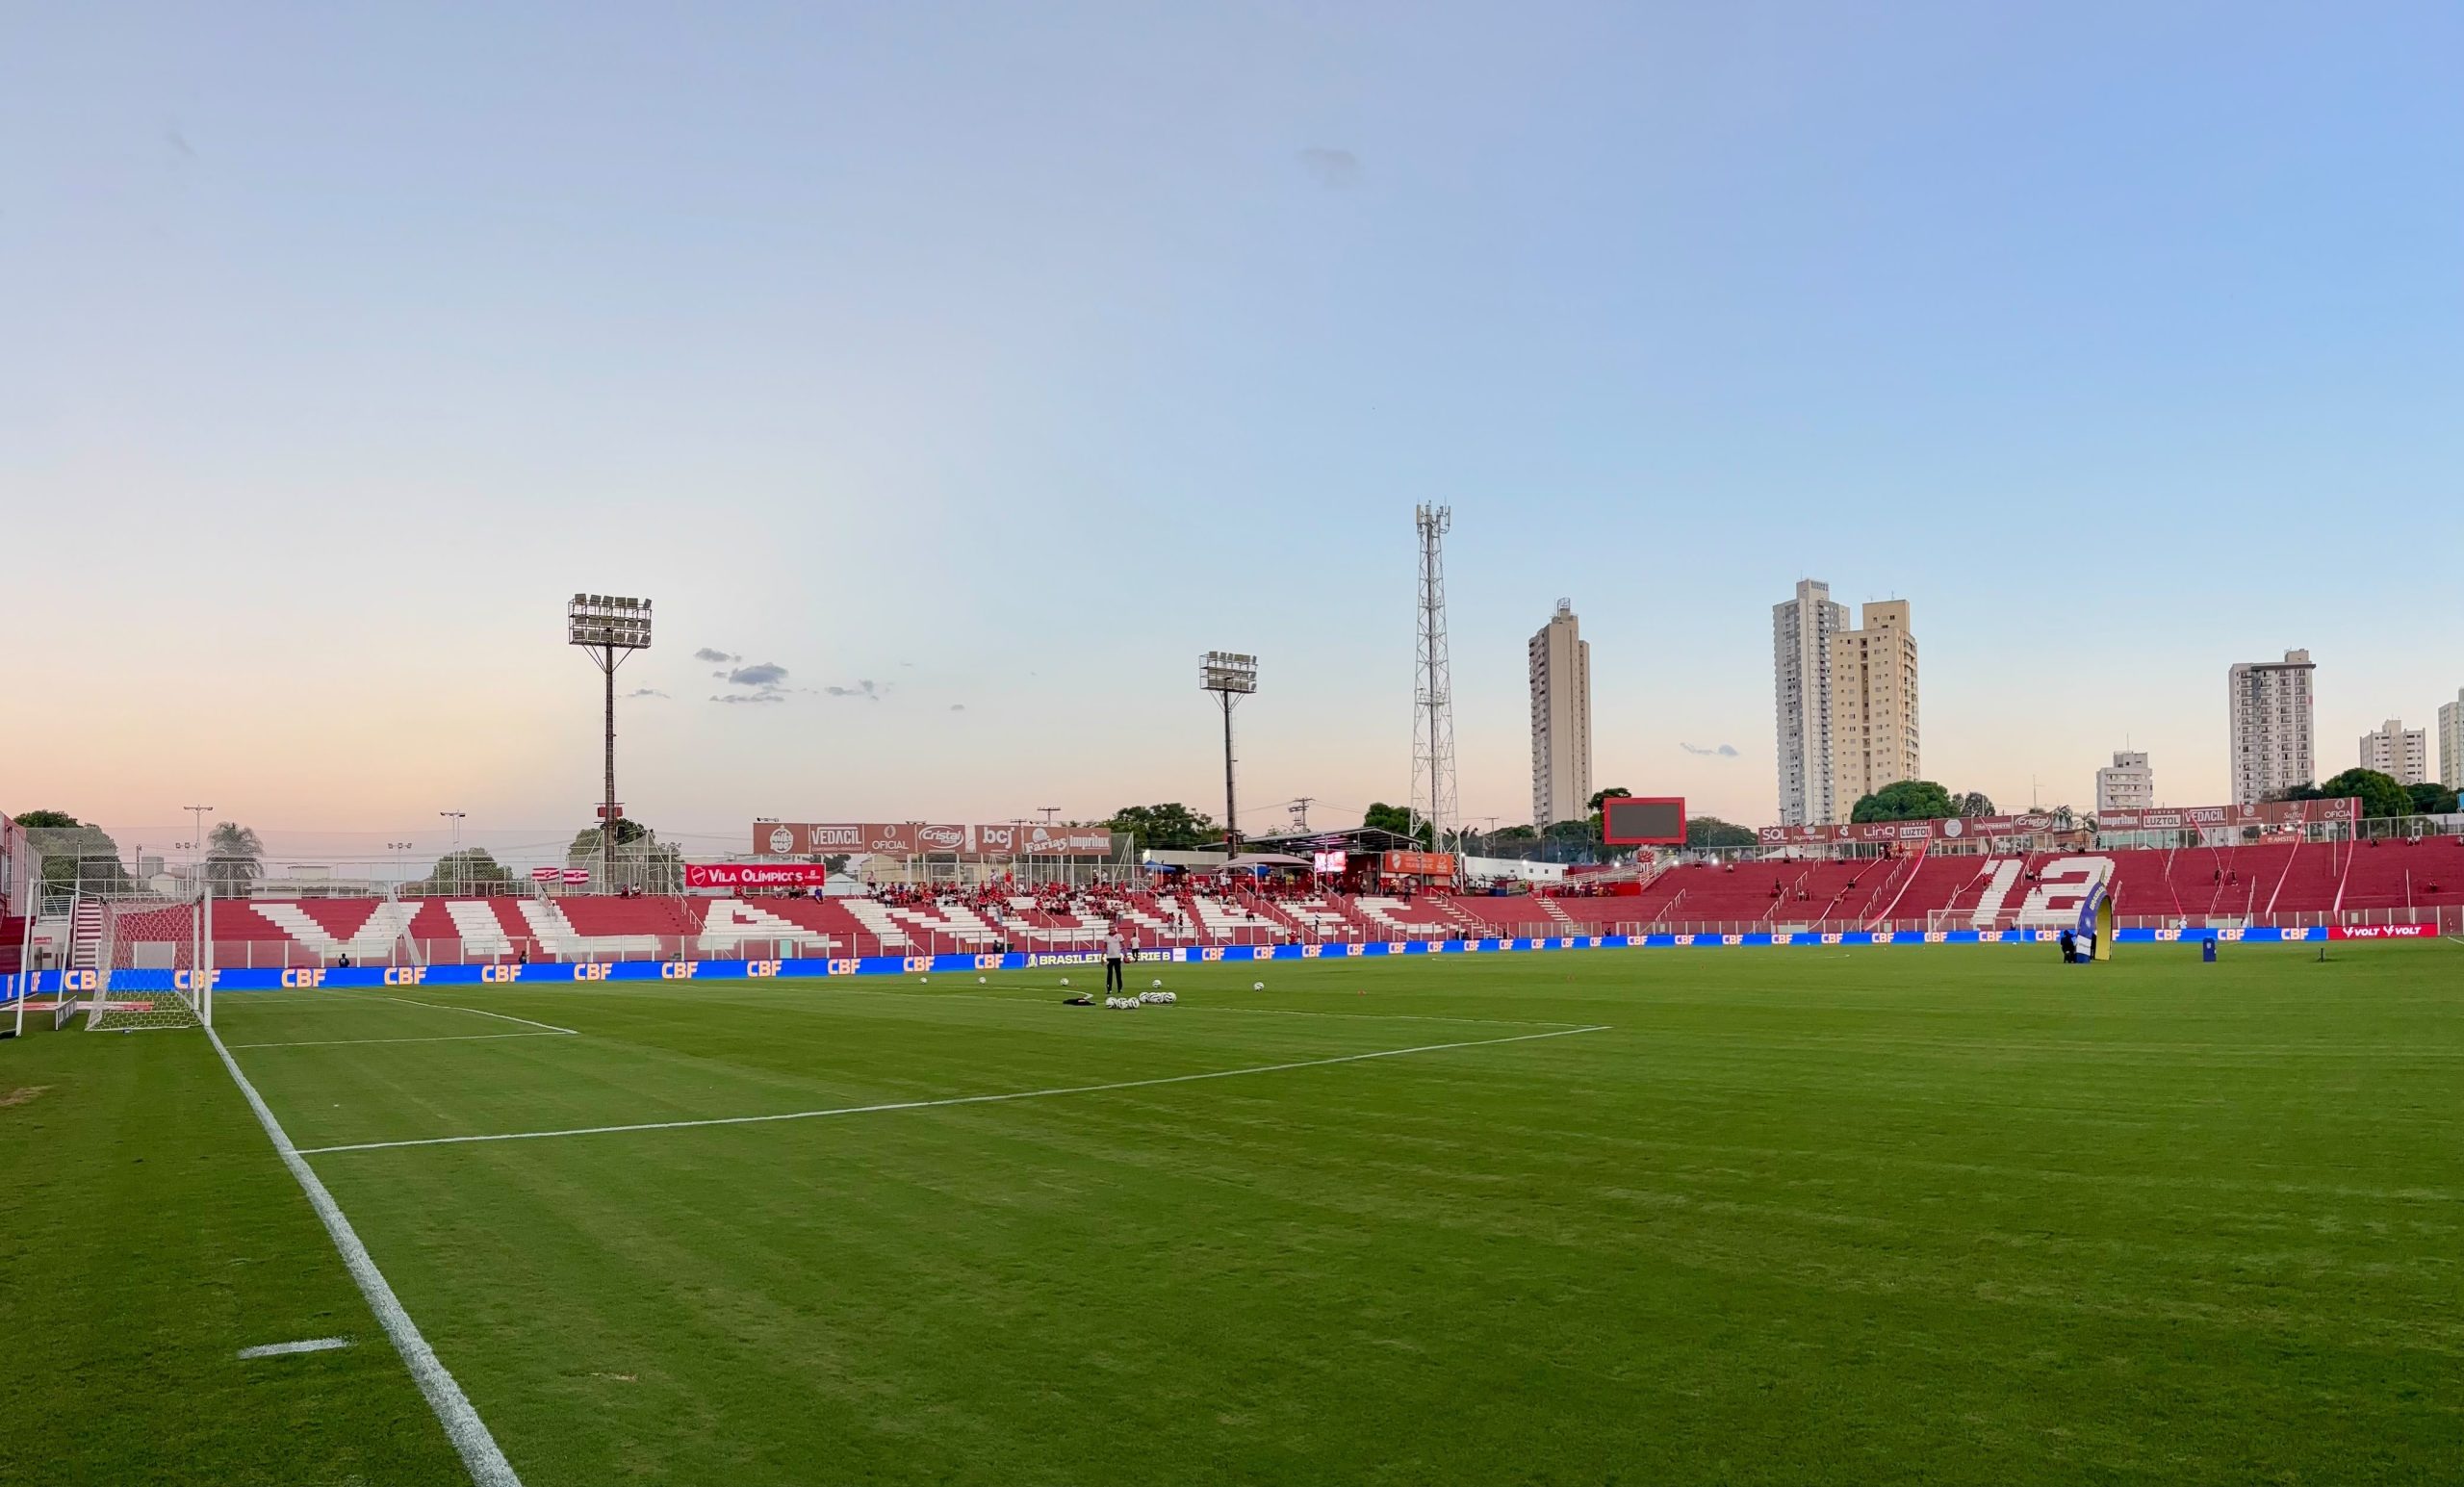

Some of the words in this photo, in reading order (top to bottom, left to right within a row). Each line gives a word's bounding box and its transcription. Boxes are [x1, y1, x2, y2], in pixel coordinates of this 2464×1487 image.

[2184, 808, 2226, 823] VEDACIL
[2324, 809, 2351, 819] OFICIA
[2017, 816, 2049, 827] Cristal
[2144, 817, 2179, 826] LUZTOL
[810, 826, 862, 845] VEDACIL
[922, 830, 962, 841] Cristal
[1761, 829, 1789, 841] SOL
[1863, 826, 1895, 837] LinQ
[871, 840, 910, 850] OFICIAL
[1024, 836, 1067, 855] Farias
[1923, 931, 1948, 943] CBF
[1978, 930, 2004, 943] CBF
[2035, 929, 2061, 942] CBF
[2154, 928, 2182, 941] CBF
[2217, 927, 2246, 941] CBF
[2280, 927, 2310, 940] CBF
[2354, 927, 2380, 936] VOLT
[2395, 926, 2422, 936] VOLT
[1627, 935, 1649, 946] CBF
[1674, 934, 1695, 946] CBF
[1722, 934, 1744, 946] CBF
[1771, 933, 1793, 945] CBF
[1821, 933, 1844, 945] CBF
[1871, 932, 1895, 944] CBF
[1201, 946, 1225, 961] CBF
[1253, 945, 1276, 961] CBF
[1301, 943, 1323, 959] CBF
[1347, 942, 1368, 957] CBF
[1388, 941, 1407, 955] CBF
[974, 953, 1005, 970] CBF
[1162, 951, 1171, 961] B
[661, 961, 699, 980] CBF
[746, 960, 783, 979] CBF
[827, 958, 861, 976] CBF
[903, 955, 936, 974] CBF
[281, 967, 327, 988] CBF
[384, 965, 427, 987] CBF
[481, 963, 523, 984] CBF
[574, 962, 613, 983] CBF
[64, 969, 113, 990] CB
